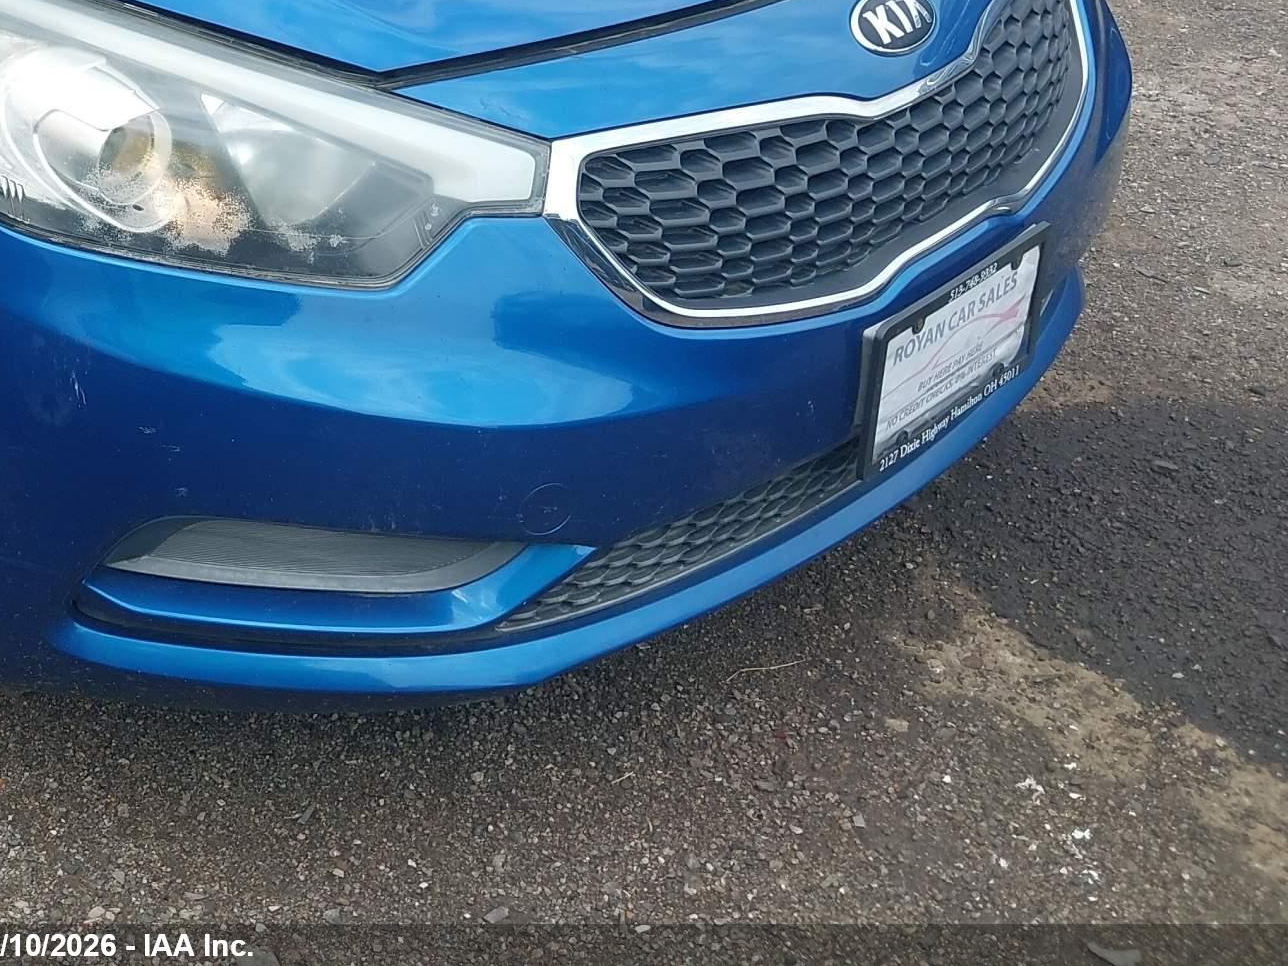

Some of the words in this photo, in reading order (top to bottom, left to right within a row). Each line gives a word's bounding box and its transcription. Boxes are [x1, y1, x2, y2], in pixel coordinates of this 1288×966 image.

[893, 321, 946, 366] ROYAN
[948, 305, 975, 331] CAR
[977, 271, 1018, 313] SALES
[879, 450, 899, 472] 2127
[900, 438, 920, 458] Dixie
[921, 415, 950, 445] Highway
[983, 380, 998, 397] OH
[998, 365, 1020, 386] 45011
